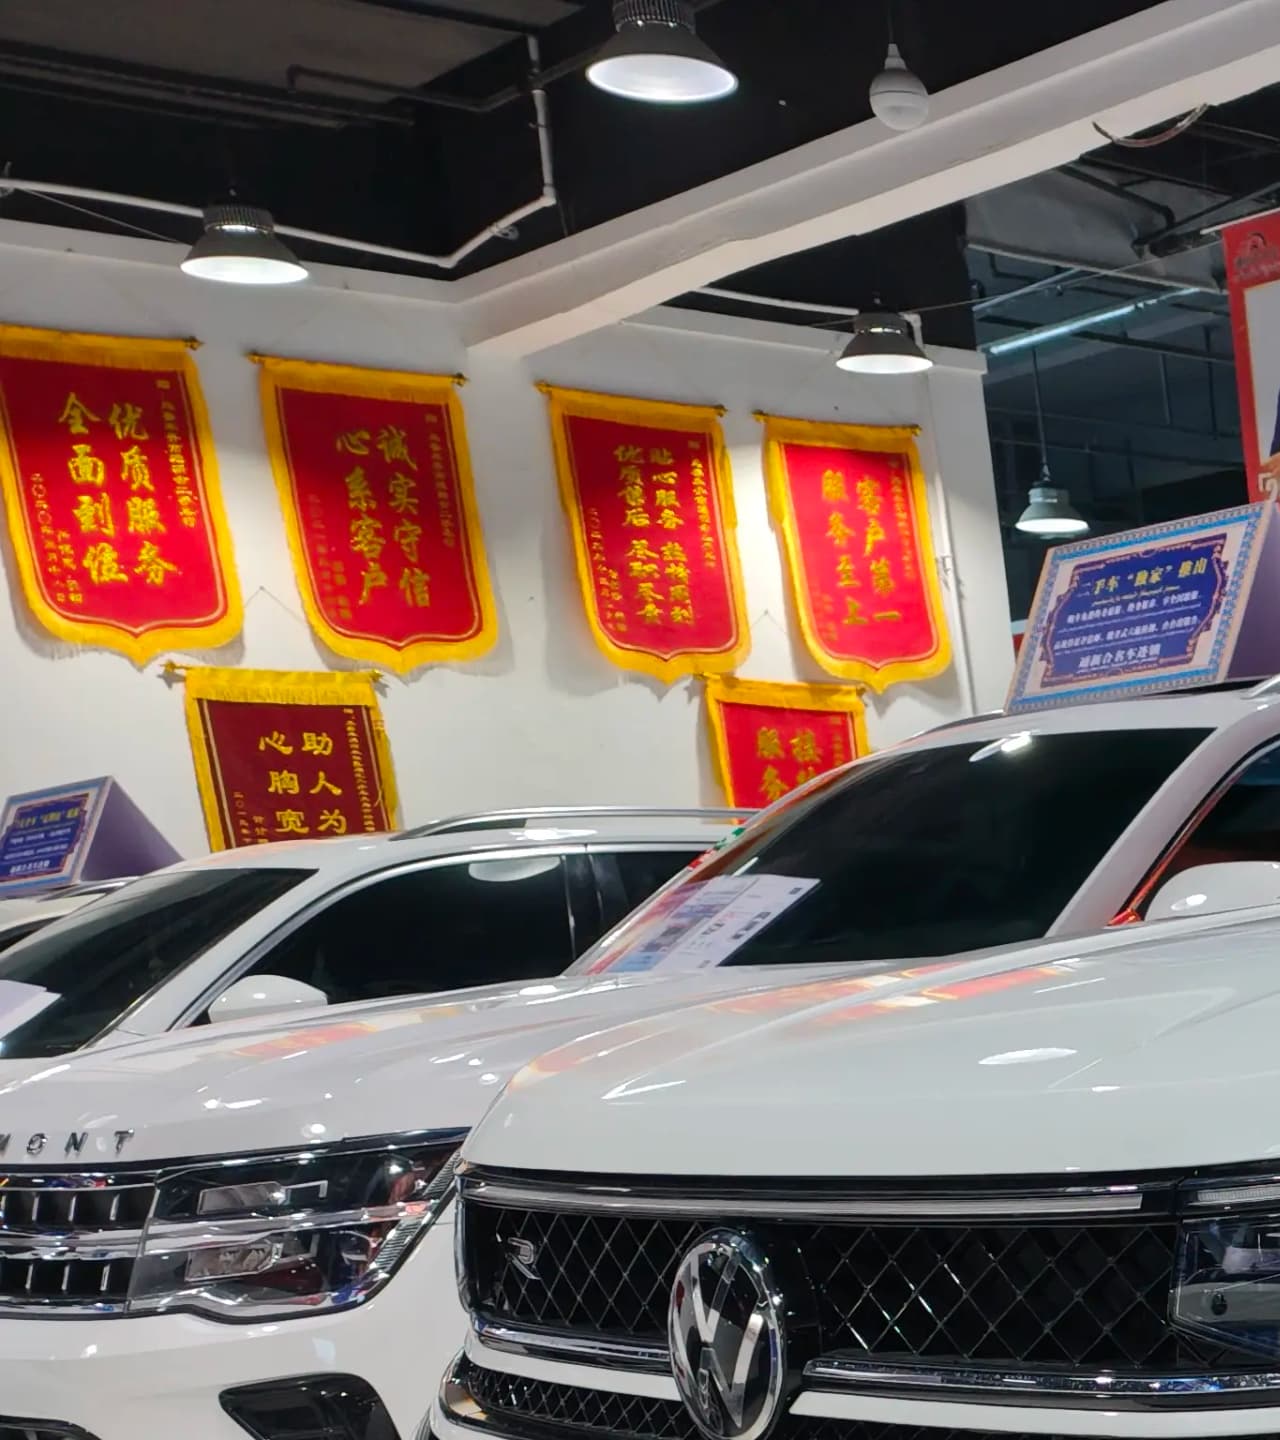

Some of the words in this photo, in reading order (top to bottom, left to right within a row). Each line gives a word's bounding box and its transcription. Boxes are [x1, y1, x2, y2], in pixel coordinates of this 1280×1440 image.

[109, 402, 178, 586] 优质服务
[335, 430, 388, 607] 心系客户
[375, 423, 431, 608] 诚实守信
[258, 731, 310, 835] 心胸宽
[301, 731, 348, 835] 助人为
